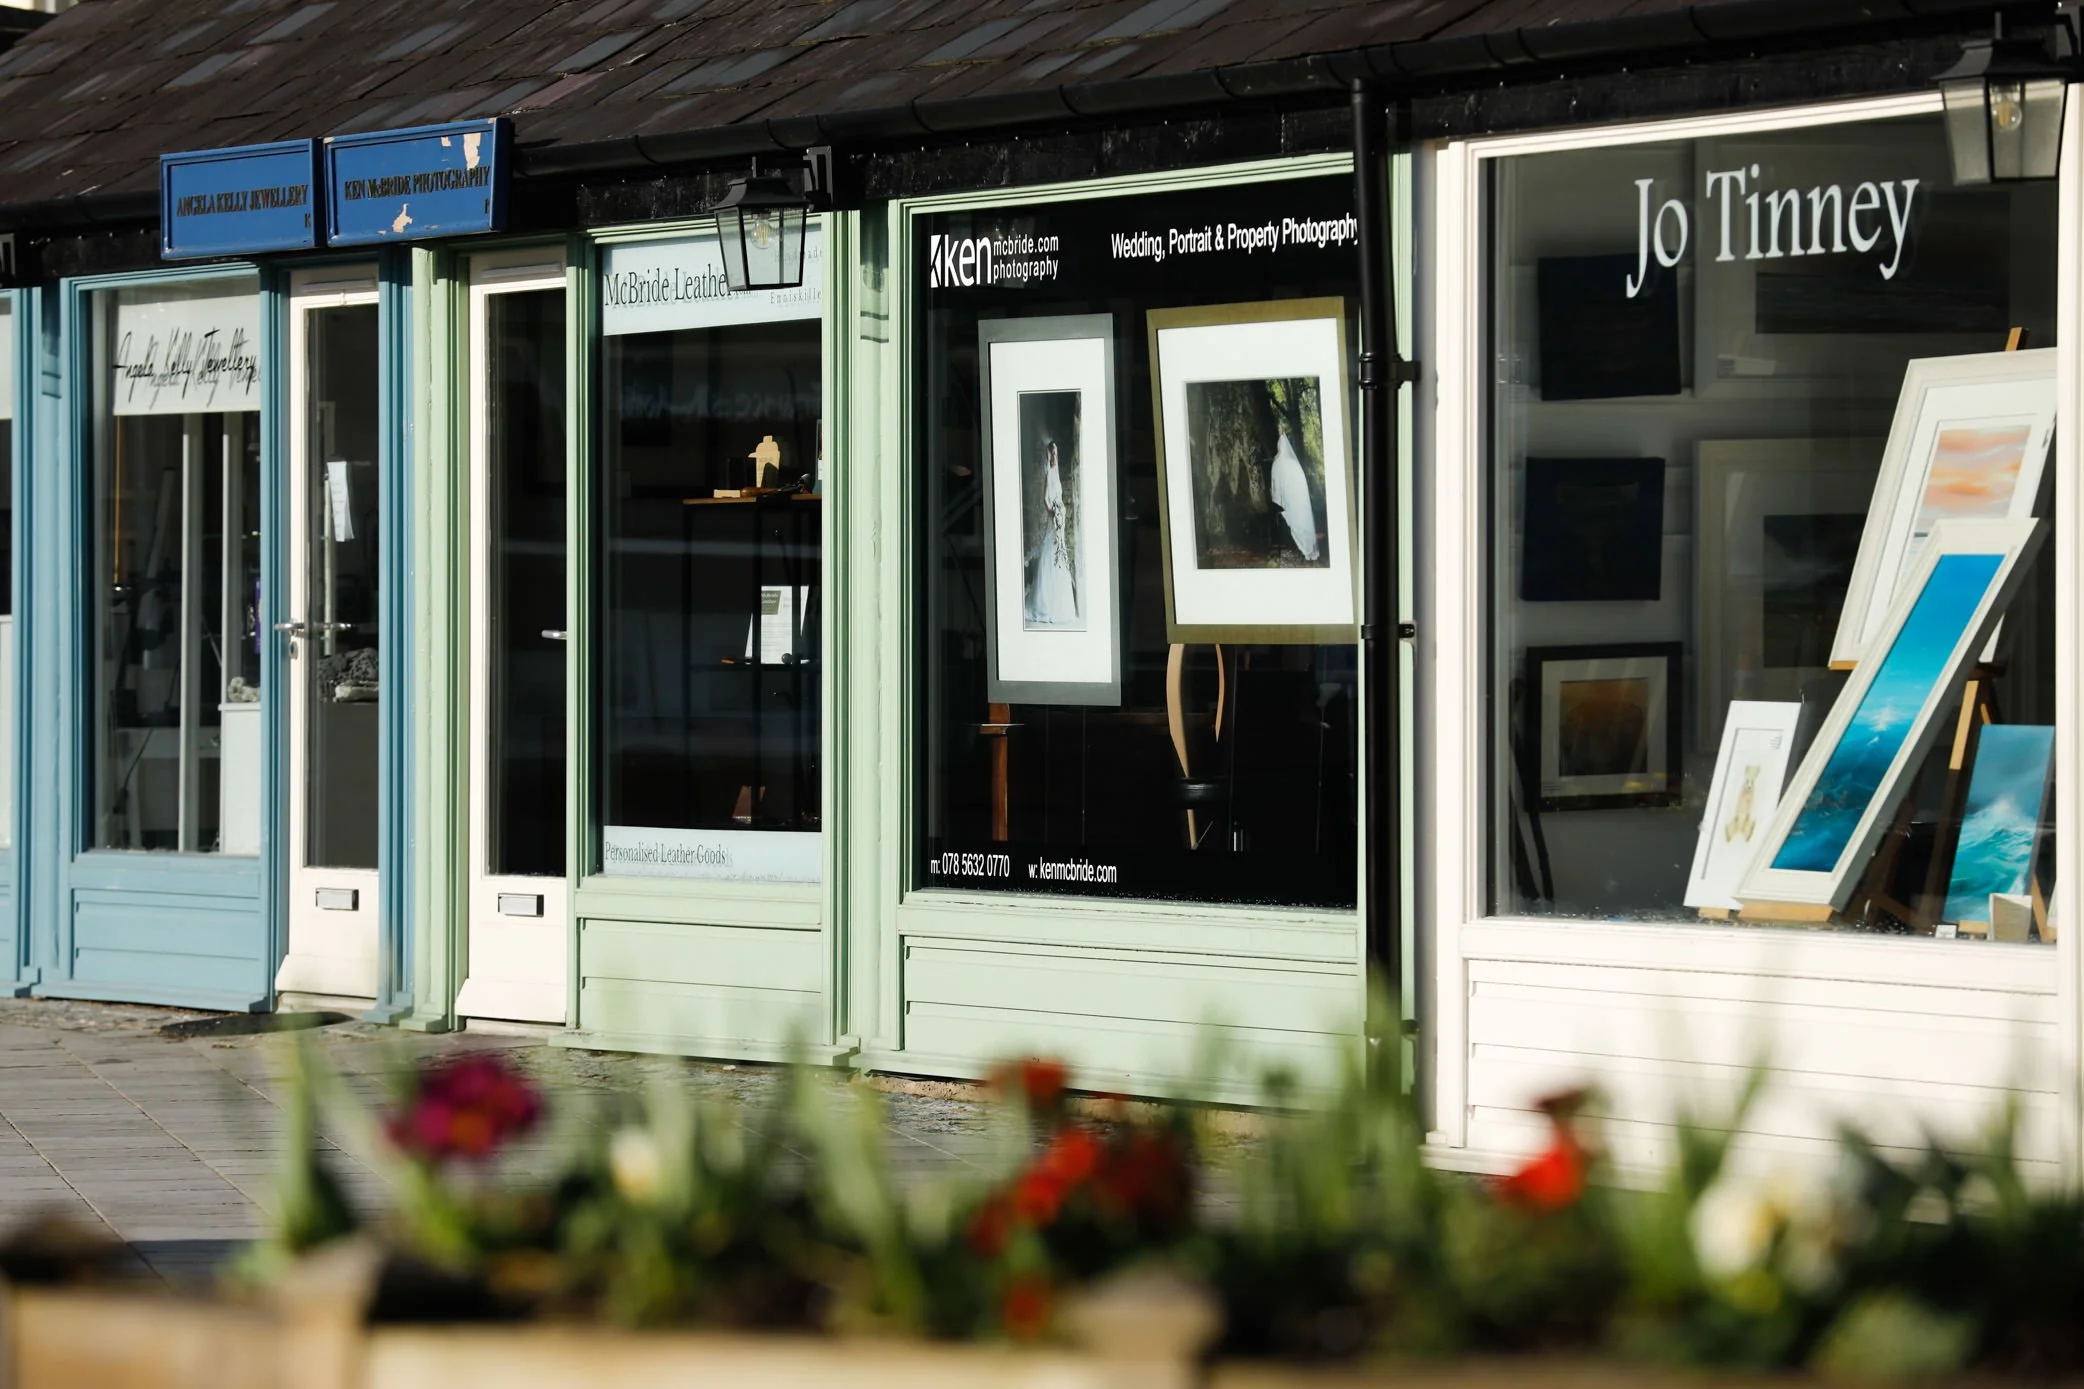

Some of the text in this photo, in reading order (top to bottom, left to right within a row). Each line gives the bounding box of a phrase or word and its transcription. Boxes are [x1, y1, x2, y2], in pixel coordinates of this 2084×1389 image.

[344, 179, 366, 200] KEN
[414, 166, 490, 194] PHOTOGRAPHY
[176, 184, 309, 217] ANGELA KELLY JEWELLERY
[993, 233, 1059, 256] mcbride.com
[1111, 212, 1358, 262] Wedding, Portrait & Property Photography
[1626, 163, 1921, 298] Jo Tinney
[993, 255, 1059, 285] photography
[605, 268, 670, 306] McBride
[605, 841, 726, 864] Personalised Leather Goods
[930, 852, 1010, 877] m: 078 5632 0770
[1028, 856, 1118, 883] w: kenmcbride.com
